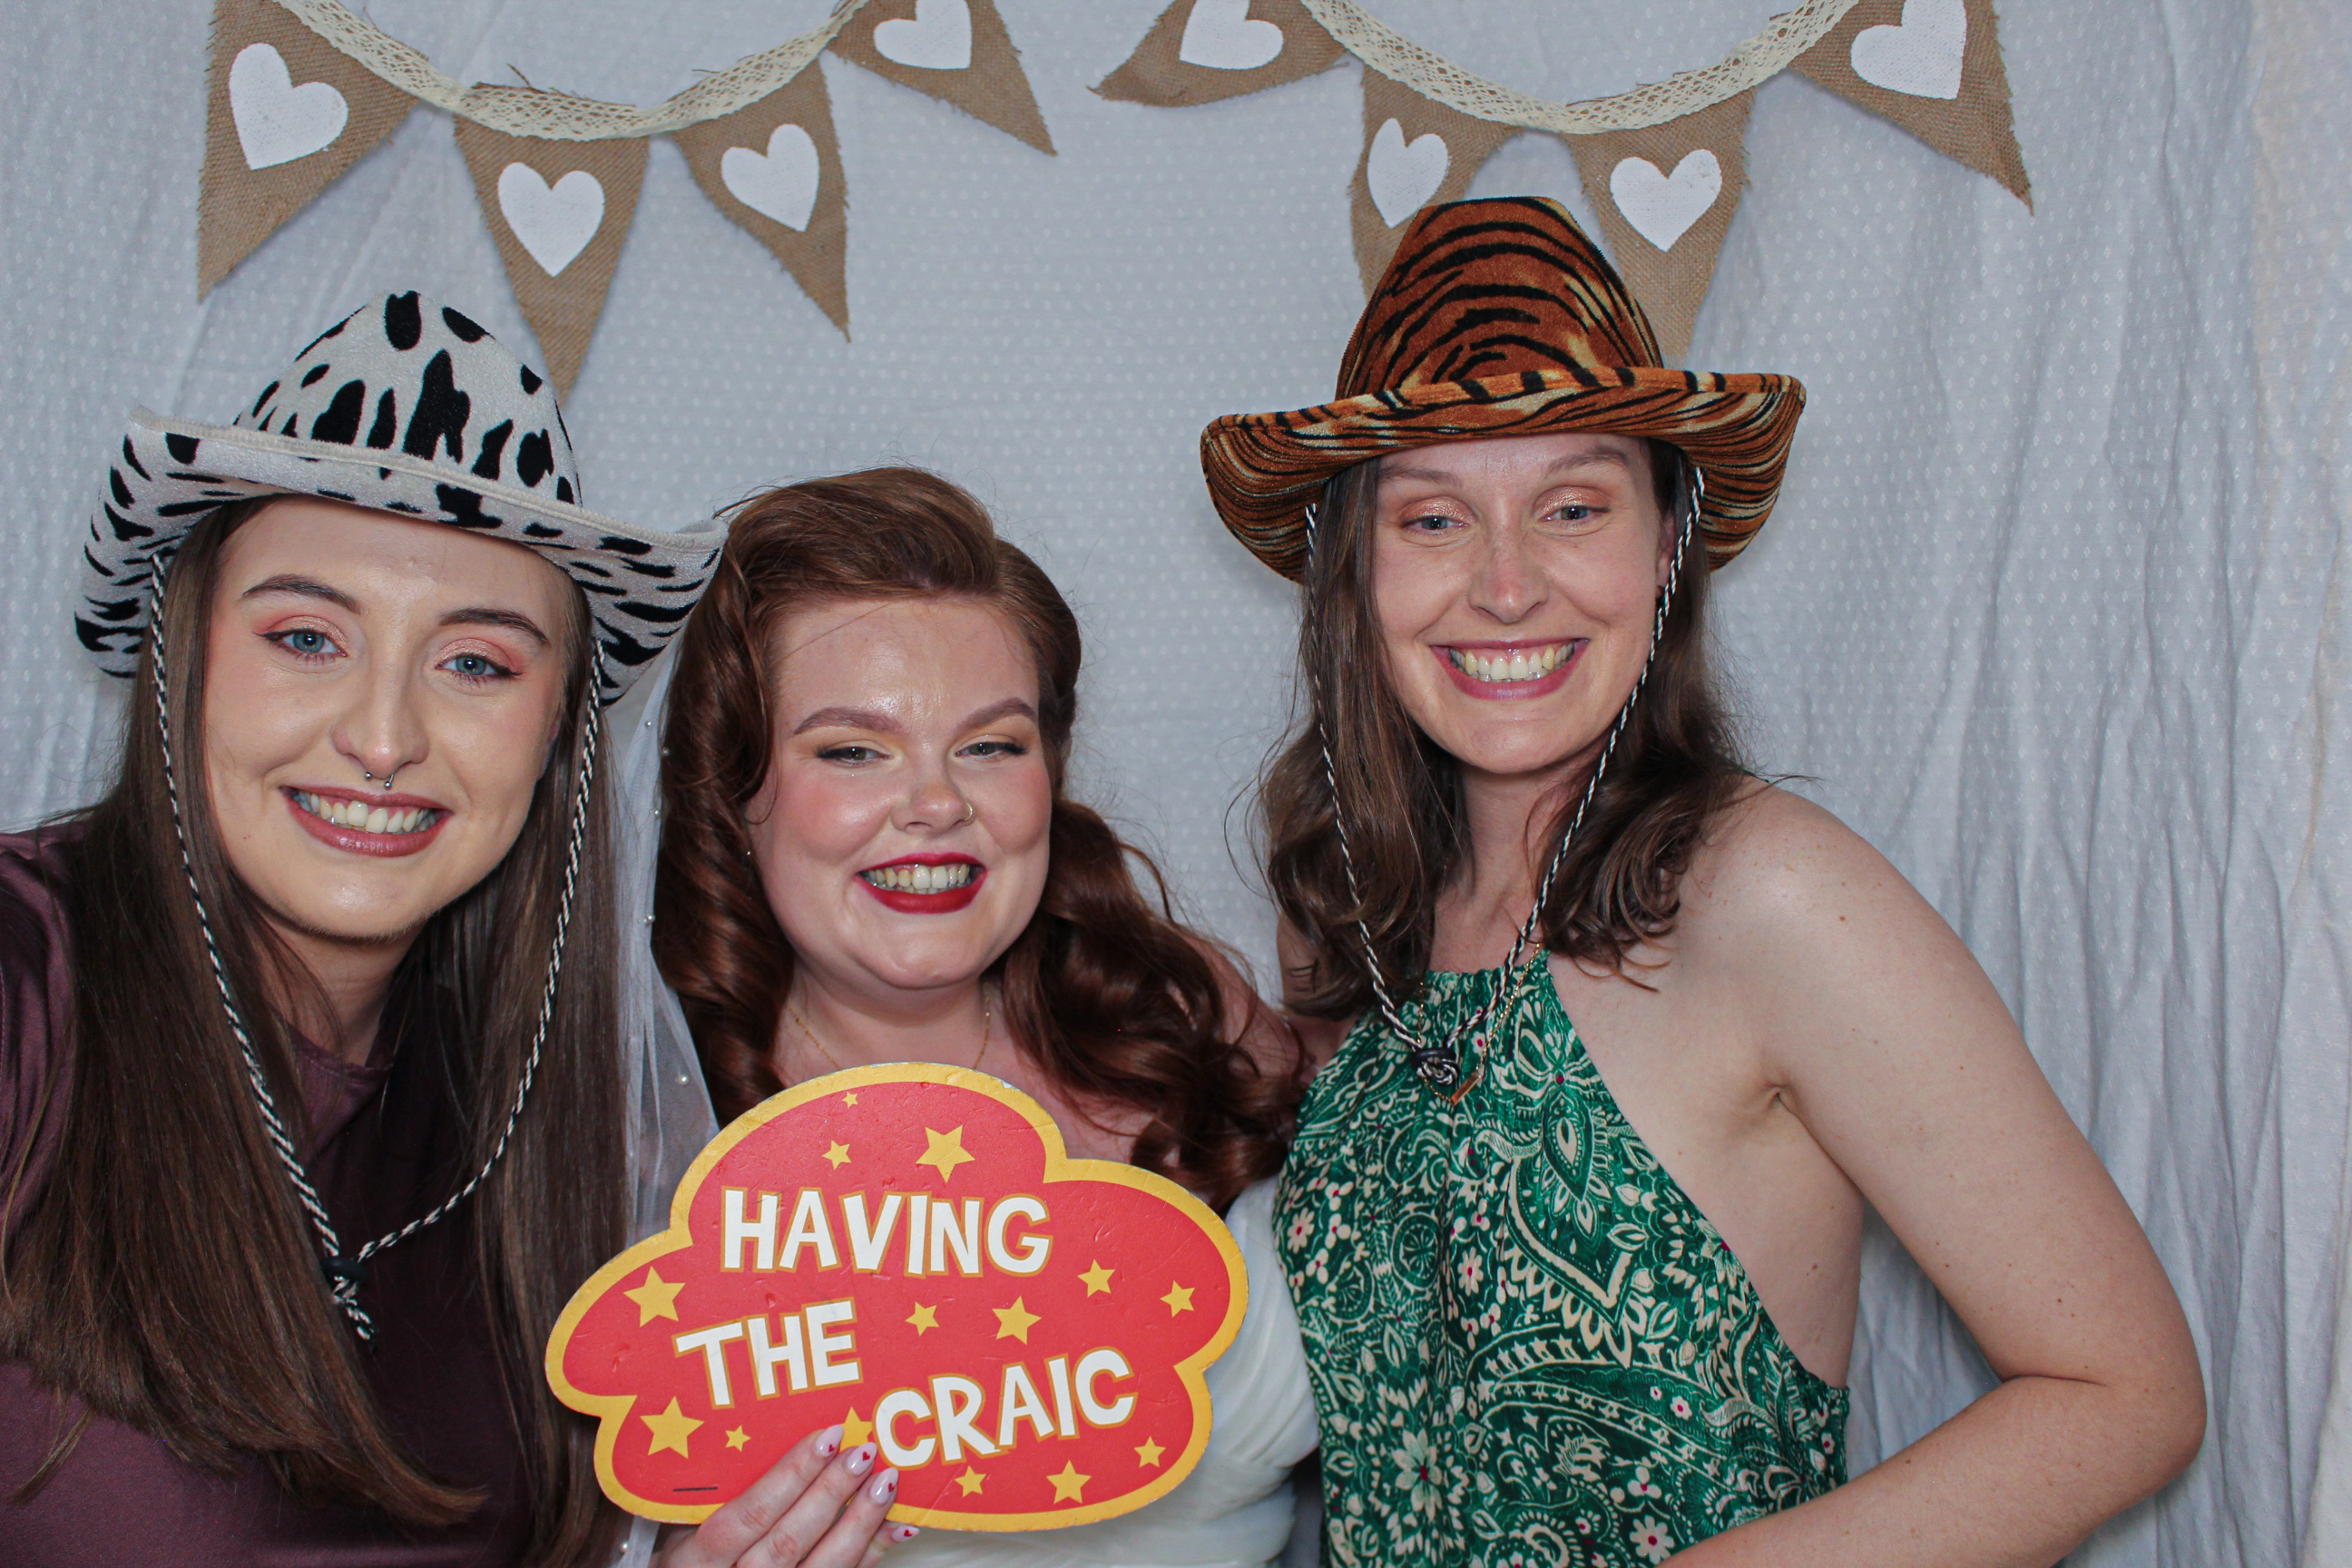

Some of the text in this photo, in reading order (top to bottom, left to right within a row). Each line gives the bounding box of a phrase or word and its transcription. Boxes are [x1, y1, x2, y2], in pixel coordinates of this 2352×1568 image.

[723, 1190, 1050, 1275] HAVING
[675, 1300, 862, 1406] THE
[876, 1350, 1134, 1467] CRAIC
